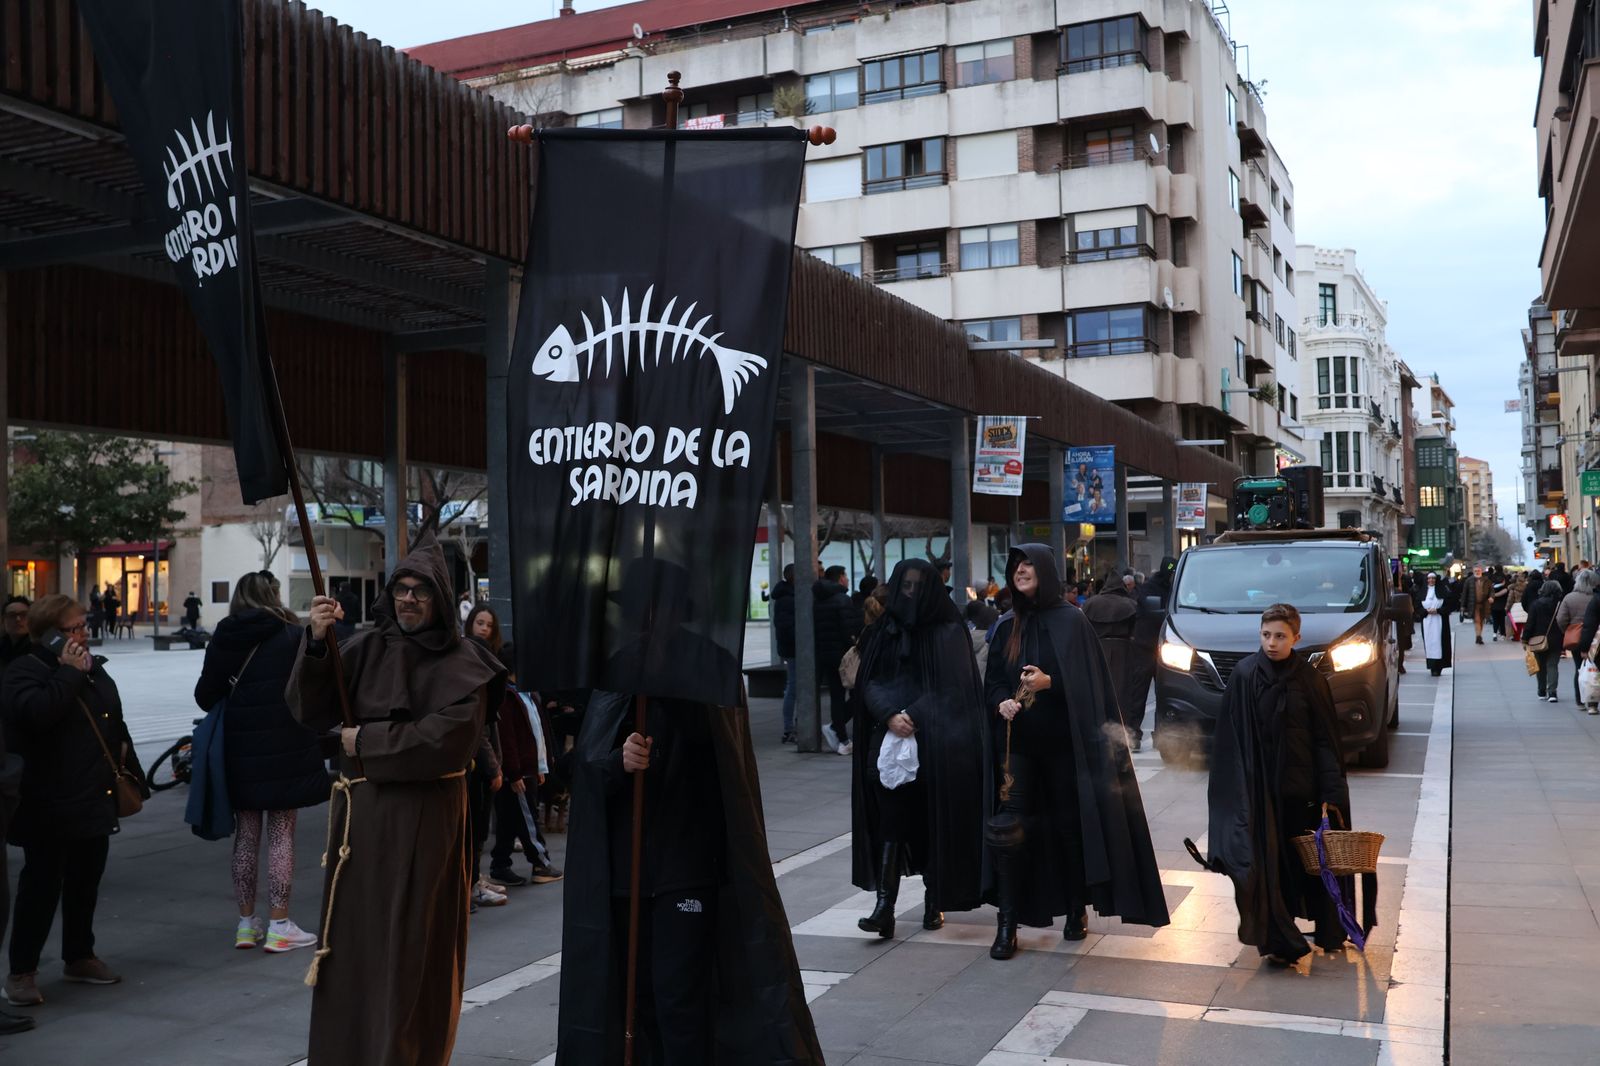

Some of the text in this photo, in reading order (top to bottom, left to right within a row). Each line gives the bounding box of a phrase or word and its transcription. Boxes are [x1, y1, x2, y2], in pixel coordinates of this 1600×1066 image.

[528, 422, 751, 468] ENTIERRO DE LA
[569, 463, 698, 510] SARDINA
